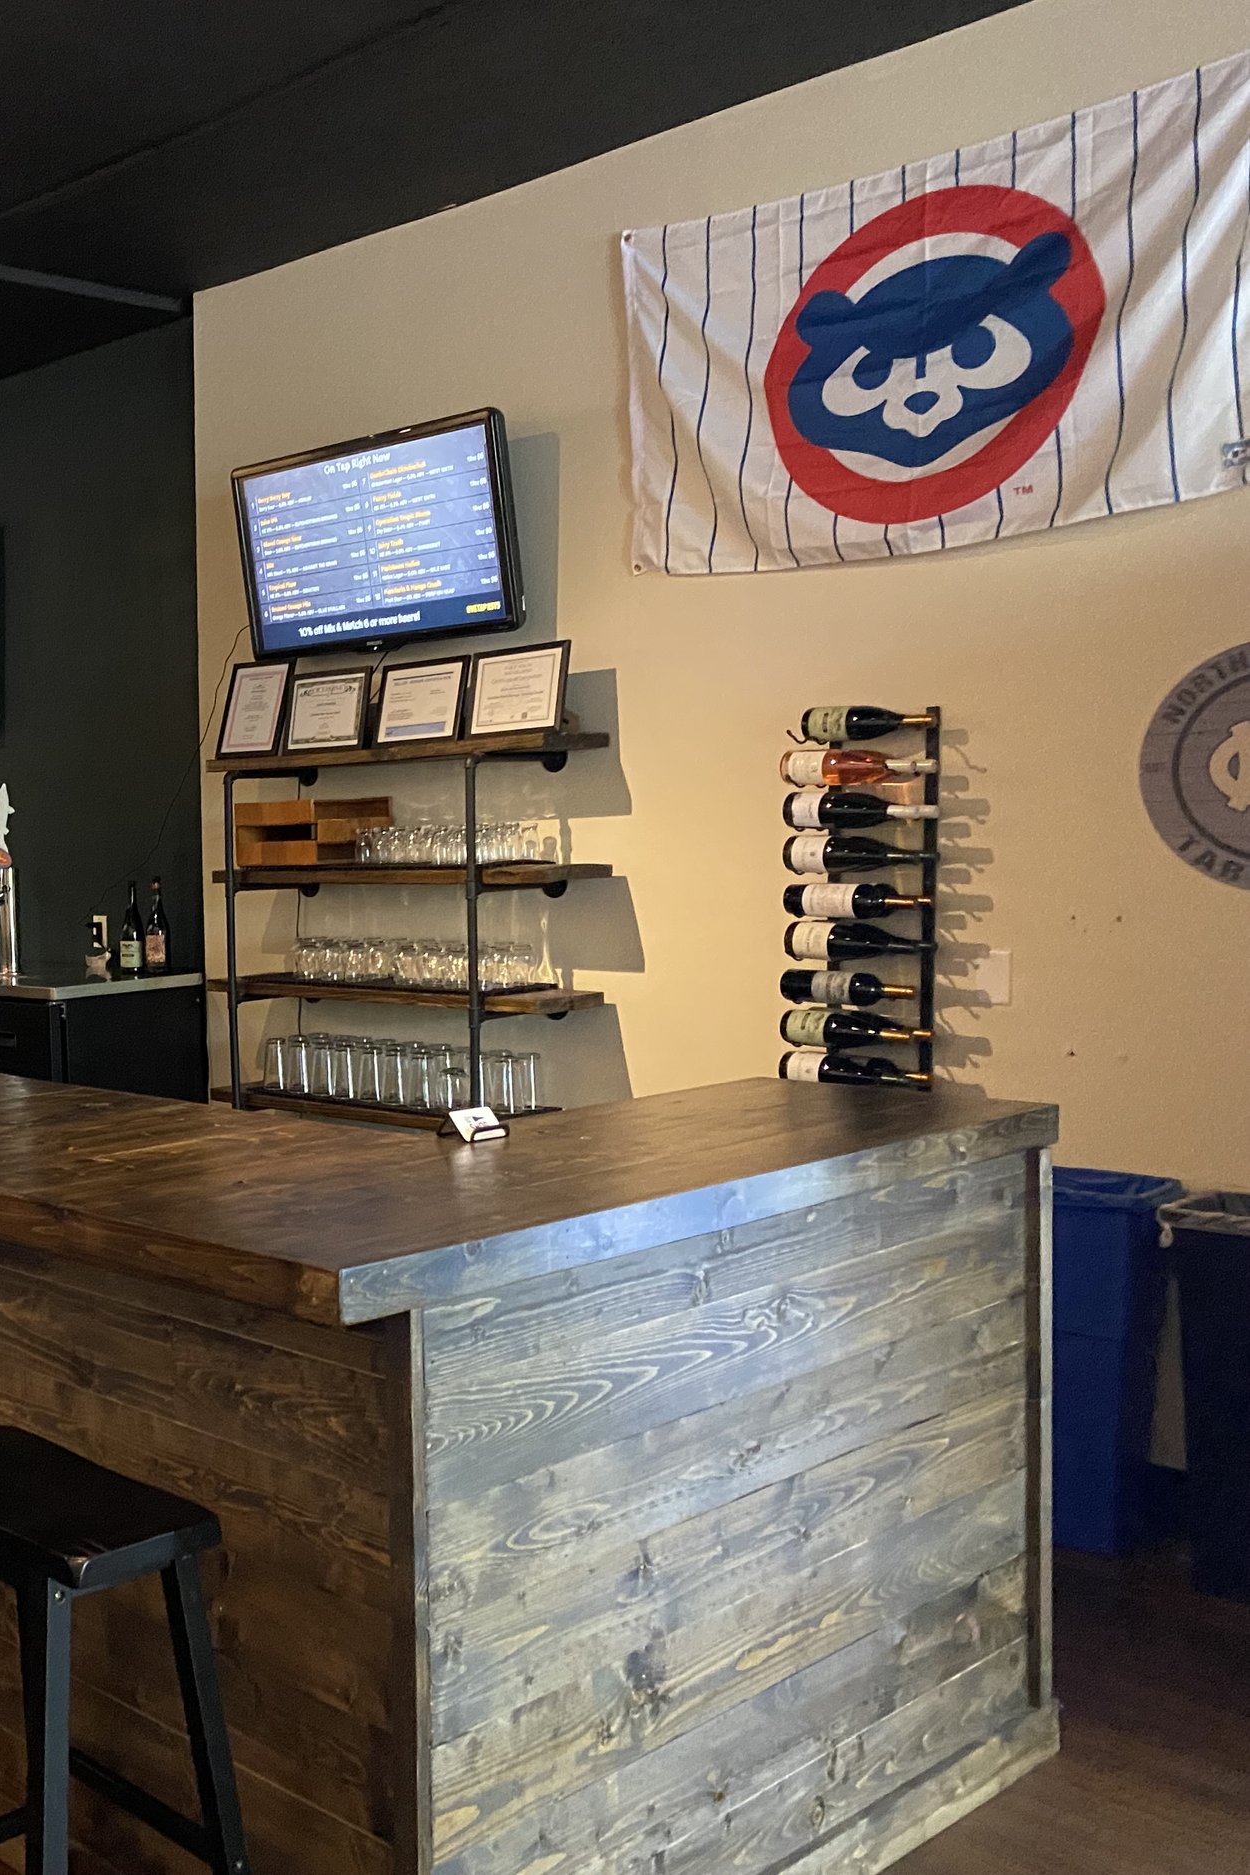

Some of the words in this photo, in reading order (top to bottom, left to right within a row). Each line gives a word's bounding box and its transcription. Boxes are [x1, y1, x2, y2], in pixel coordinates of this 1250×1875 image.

[323, 464, 335, 475] On
[336, 462, 350, 474] Tap
[351, 456, 371, 470] Right
[1012, 484, 1034, 496] TM
